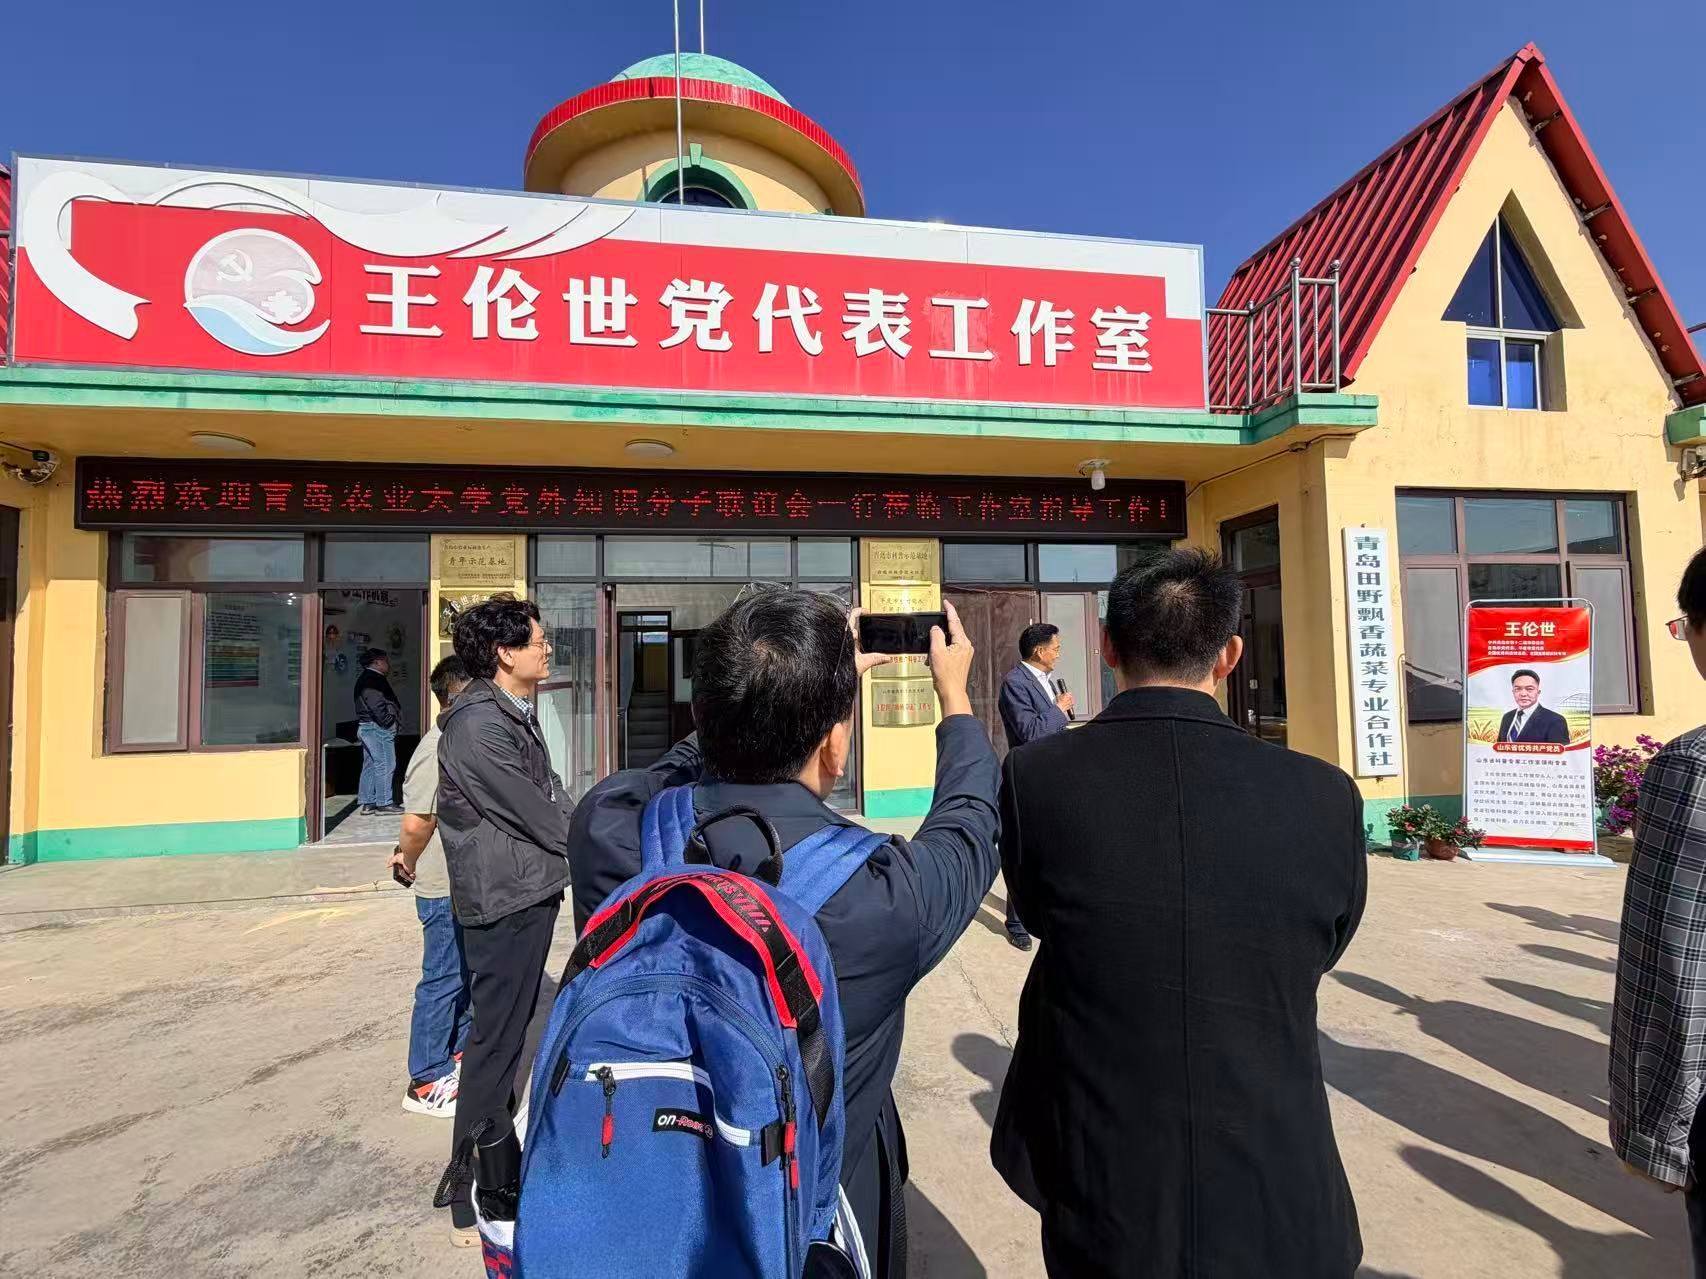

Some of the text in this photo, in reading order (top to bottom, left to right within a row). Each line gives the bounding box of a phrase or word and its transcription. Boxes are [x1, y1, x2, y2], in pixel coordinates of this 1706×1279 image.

[359, 262, 1153, 373] 王伦世党代表工作室
[1353, 536, 1394, 767] 青岛田野飘香蔬菜专业合作社
[1504, 621, 1556, 637] 王伦世
[1496, 743, 1561, 753] 山东省优秀共产党员
